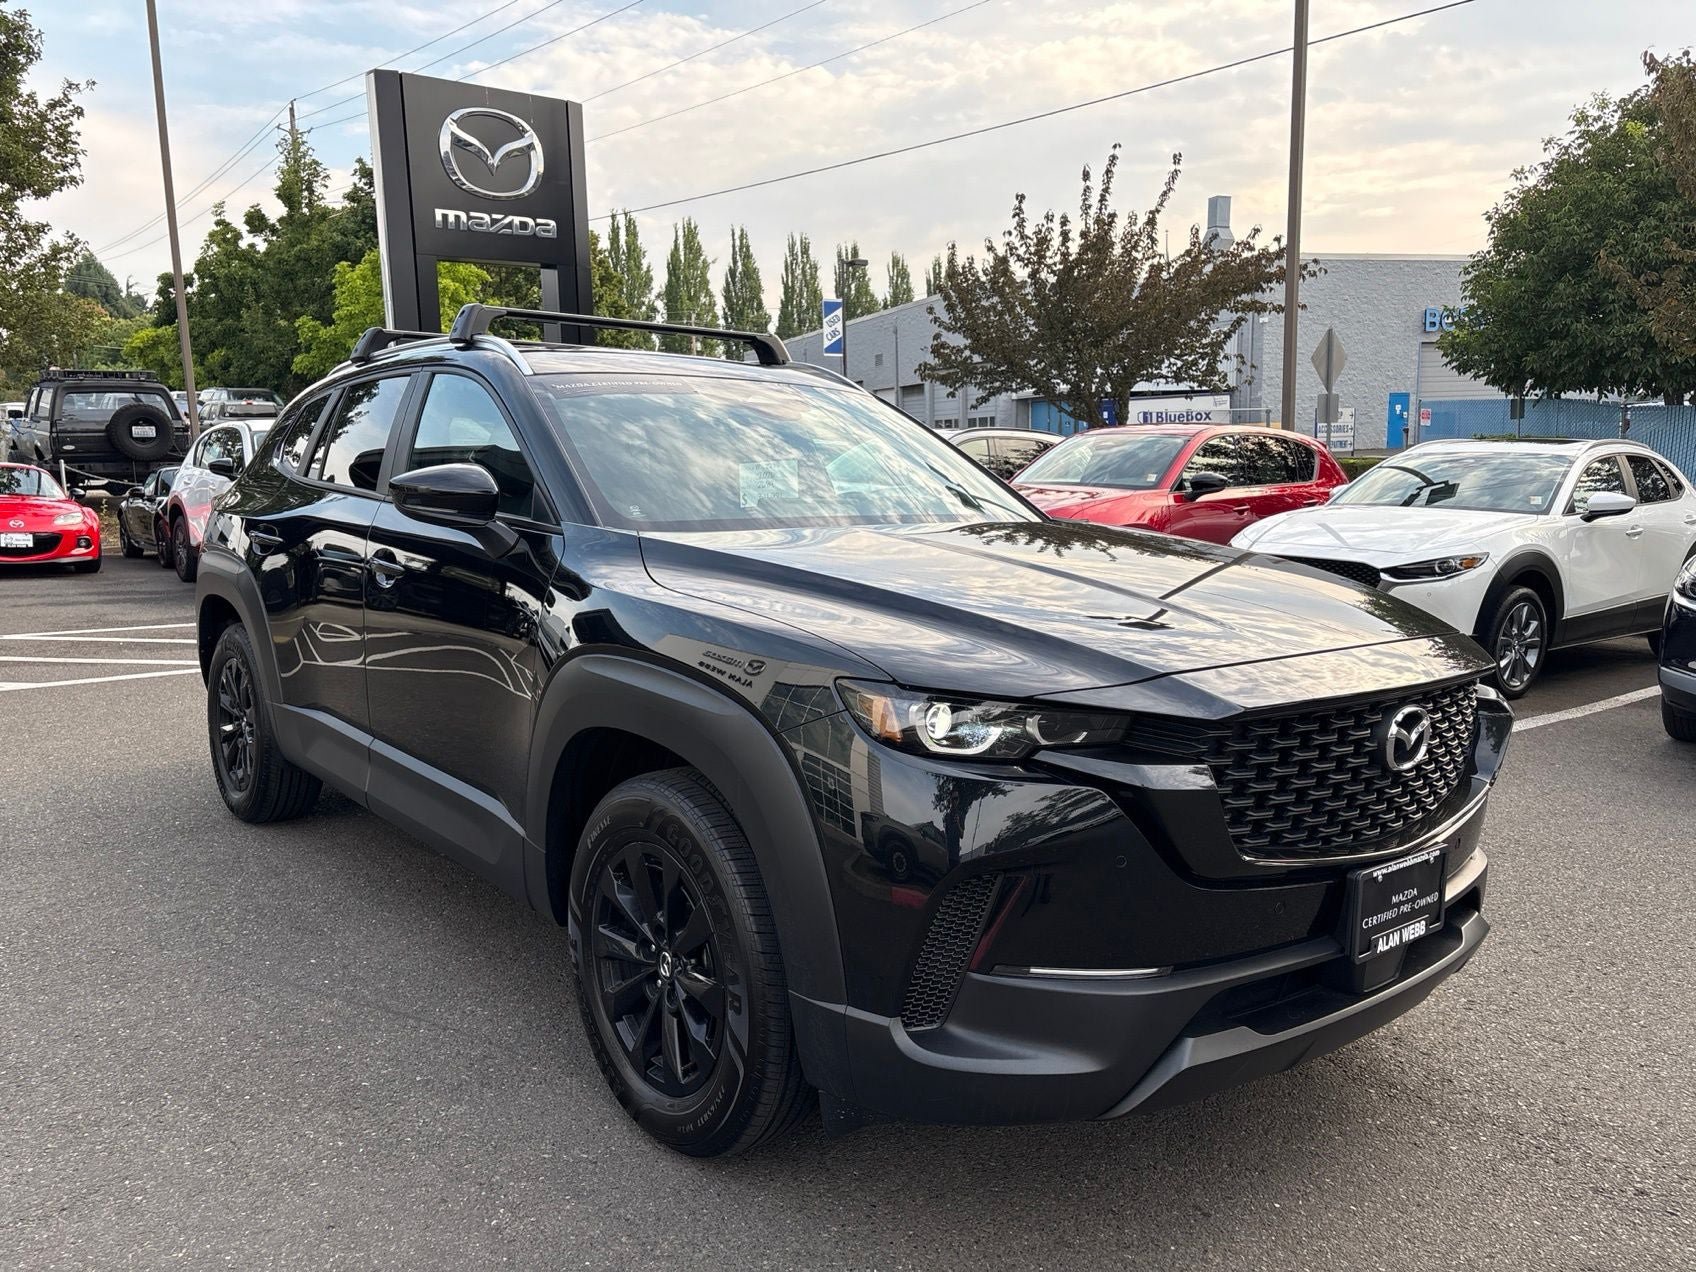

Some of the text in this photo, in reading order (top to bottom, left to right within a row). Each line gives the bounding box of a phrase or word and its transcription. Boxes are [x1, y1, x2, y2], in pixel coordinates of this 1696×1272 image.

[825, 314, 841, 328] USED
[825, 327, 841, 341] CARS
[1391, 888, 1418, 904] MAZDA
[1362, 892, 1439, 929] CERTIFIED PRE-OWNED
[1377, 920, 1426, 954] ALAN WEBB
